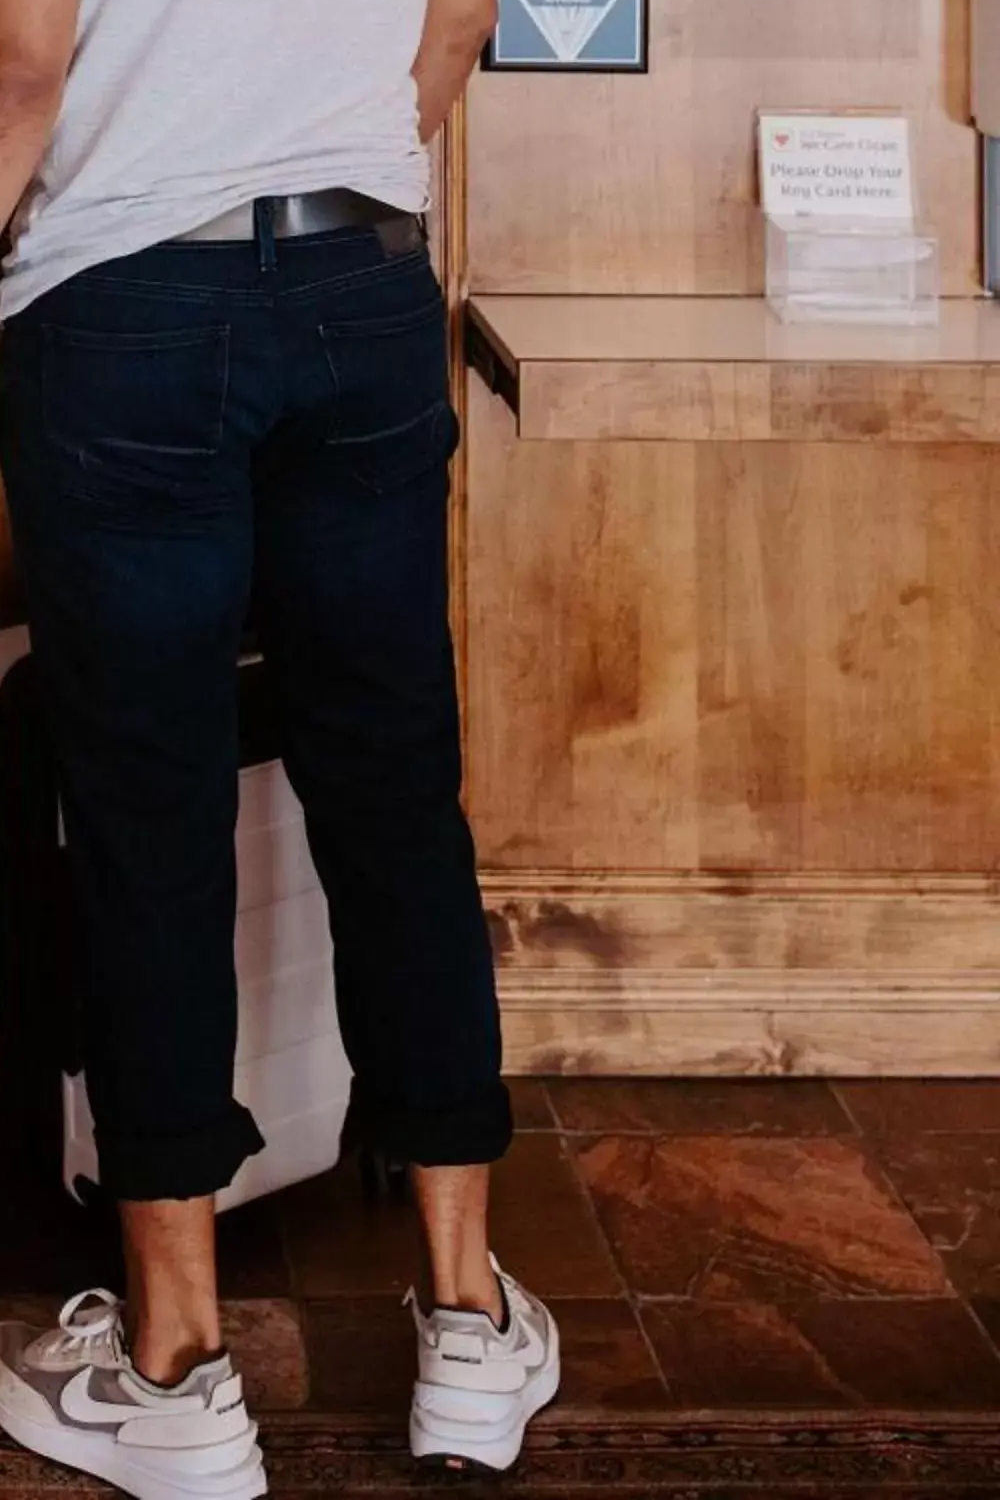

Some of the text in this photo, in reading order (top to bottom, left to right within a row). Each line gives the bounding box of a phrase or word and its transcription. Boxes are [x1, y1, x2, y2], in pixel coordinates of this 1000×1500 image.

[770, 162, 903, 180] Please Drop Your
[781, 184, 811, 199] Key
[814, 183, 851, 198] Card
